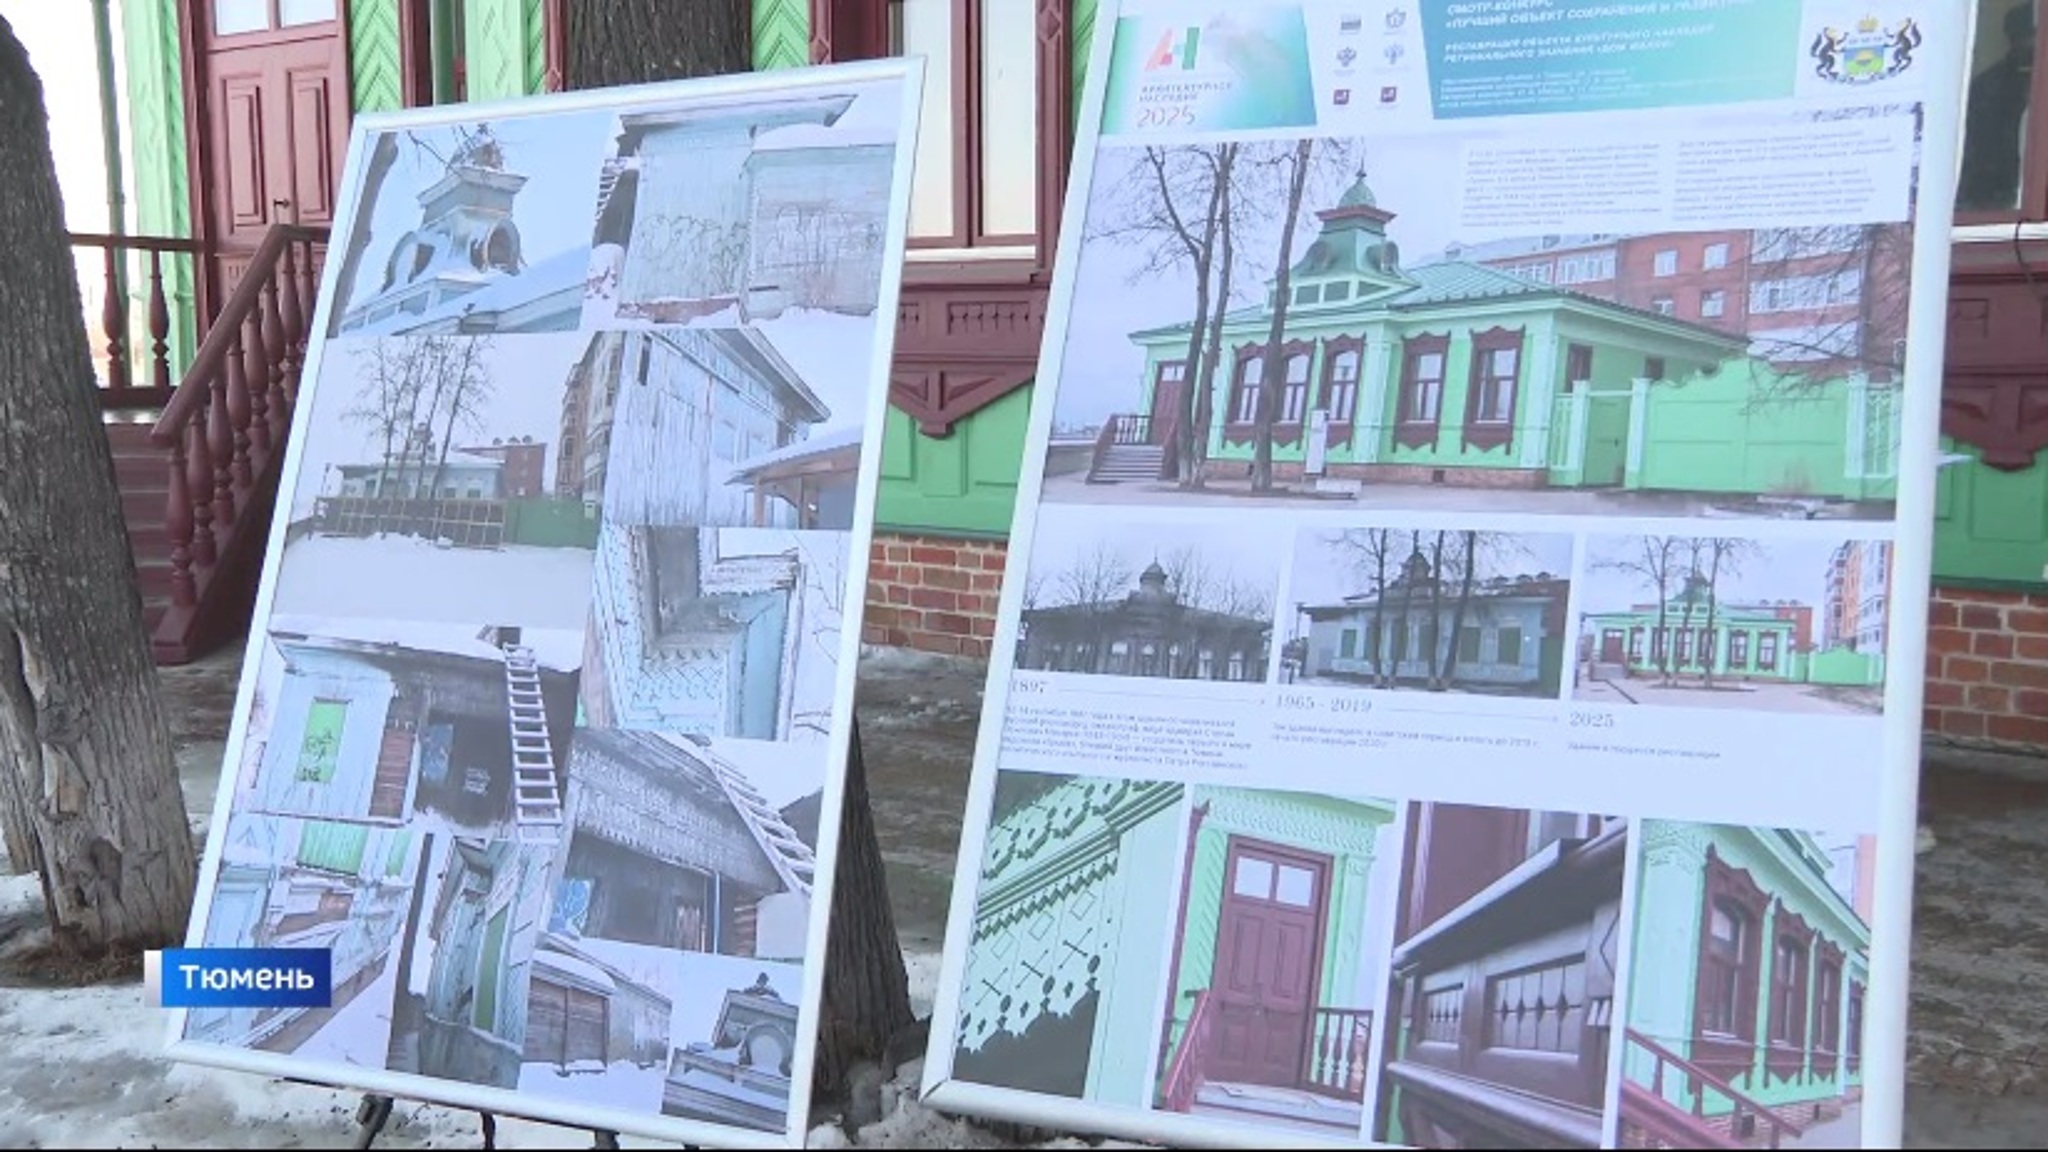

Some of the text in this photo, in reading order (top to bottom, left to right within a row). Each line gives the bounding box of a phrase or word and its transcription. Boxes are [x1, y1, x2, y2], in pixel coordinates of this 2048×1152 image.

[1137, 104, 1196, 128] 2025
[1010, 680, 1050, 693] 1897
[1277, 694, 1315, 710] 1965
[1330, 697, 1372, 713] 2019
[1568, 711, 1614, 728] 2025
